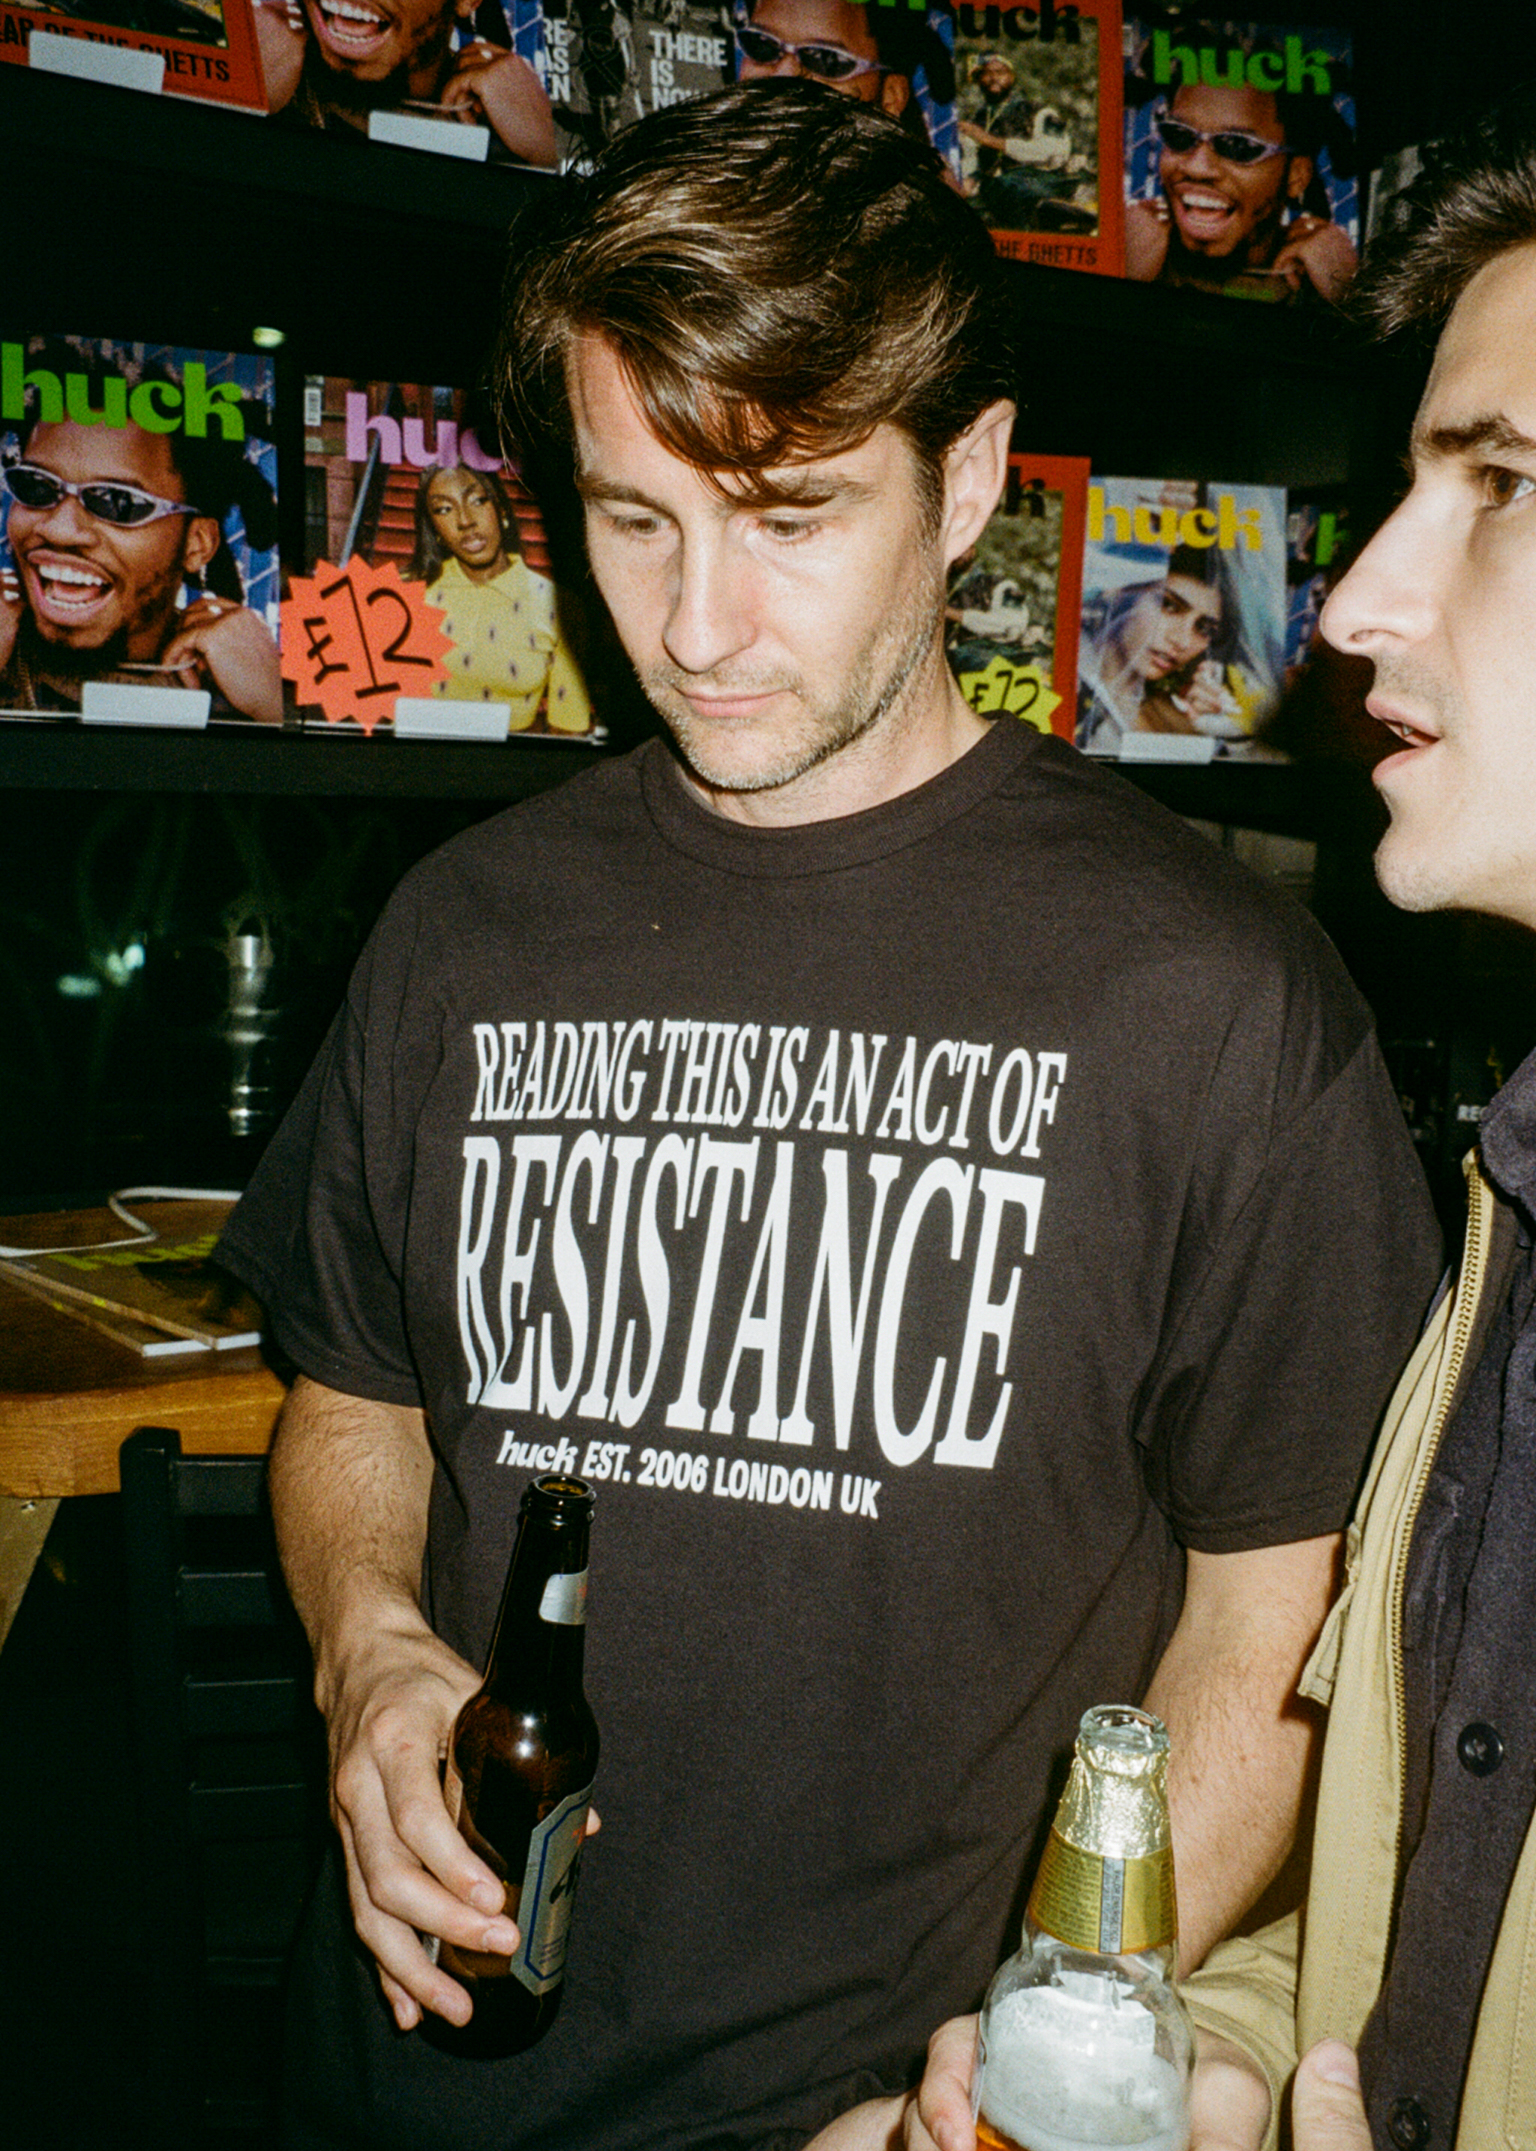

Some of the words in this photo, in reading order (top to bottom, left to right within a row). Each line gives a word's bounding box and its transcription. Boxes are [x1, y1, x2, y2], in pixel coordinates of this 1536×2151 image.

[648, 29, 728, 67] THERE
[951, 0, 1081, 43] uck
[1153, 29, 1332, 95] huck
[650, 59, 674, 87] IS
[0, 342, 244, 441] huck
[346, 391, 522, 474] huc
[1087, 486, 1262, 551] huck
[302, 575, 434, 699] £12
[470, 1018, 655, 1123] READING
[651, 1017, 762, 1129] THIS
[752, 1025, 811, 1131] IS
[799, 1028, 889, 1136] AN
[875, 1036, 994, 1150] ACT
[987, 1047, 1068, 1159] OF
[456, 1129, 1047, 1470] RESISTANCE
[496, 1429, 579, 1475] huck
[580, 1440, 632, 1484] EST.
[636, 1447, 710, 1494] 2006
[712, 1456, 835, 1511] LONDON
[839, 1473, 883, 1520] UK
